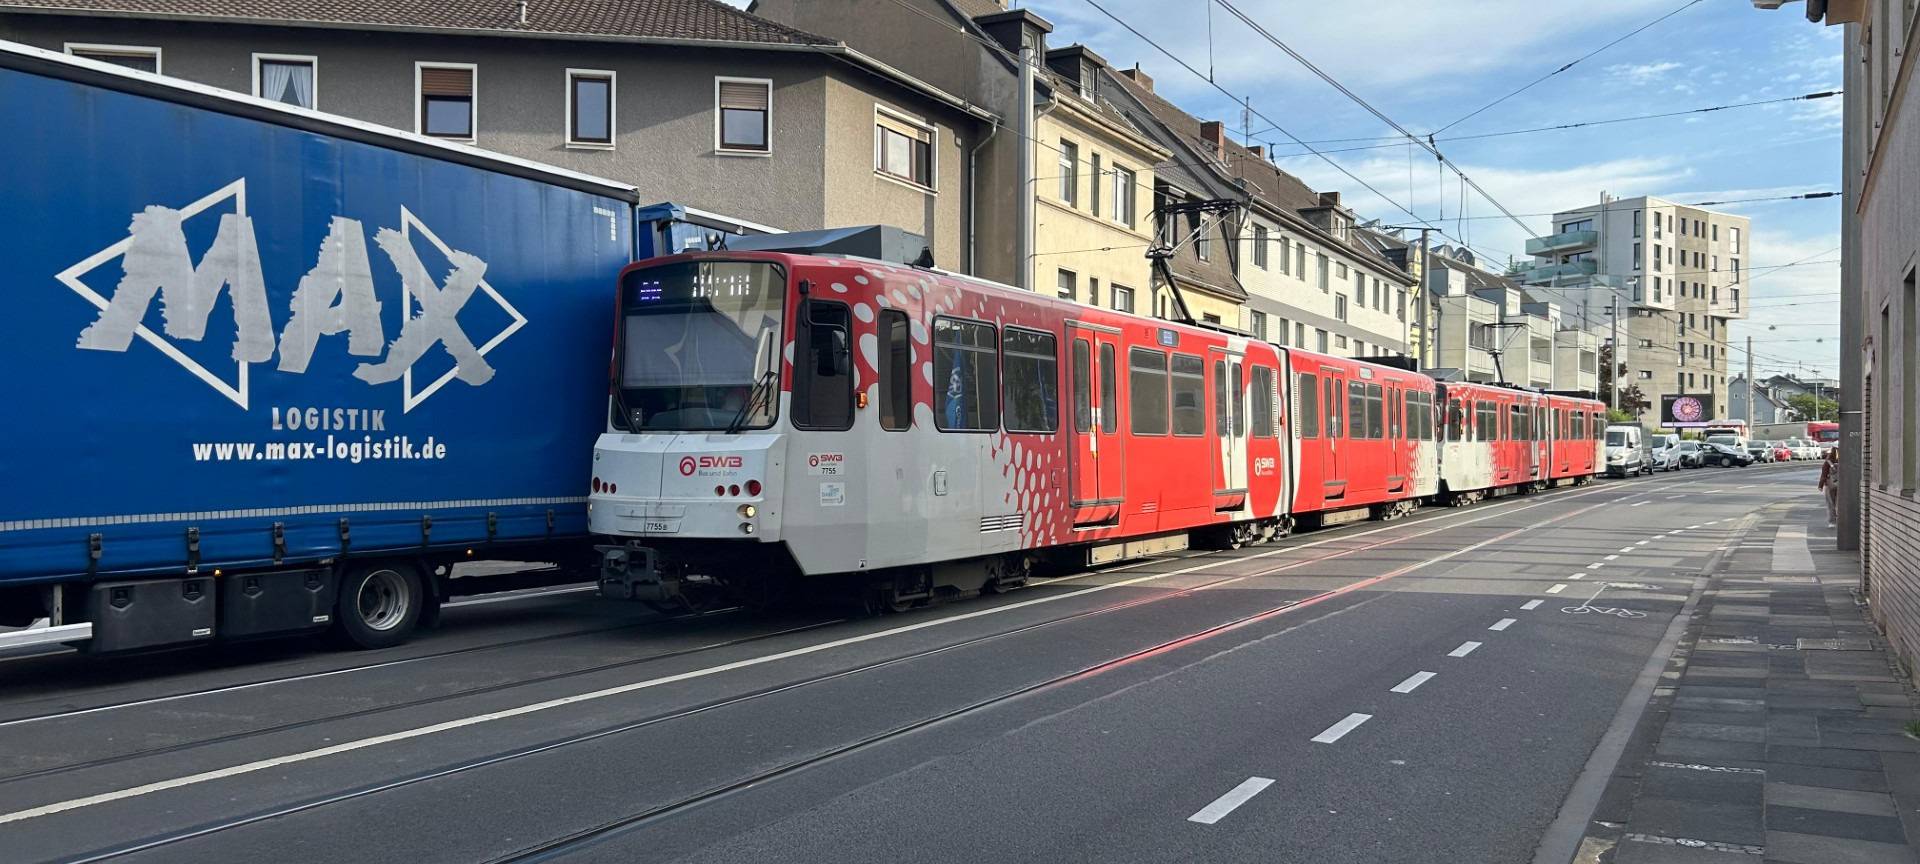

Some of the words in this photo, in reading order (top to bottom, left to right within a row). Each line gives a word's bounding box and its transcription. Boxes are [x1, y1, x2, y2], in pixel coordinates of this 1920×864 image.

[76, 204, 496, 386] MAX
[271, 407, 386, 431] LOGISTIK
[193, 435, 447, 463] www.max-logistik.de
[821, 454, 843, 462] SWB
[700, 455, 743, 468] SWB
[822, 467, 837, 475] 7755
